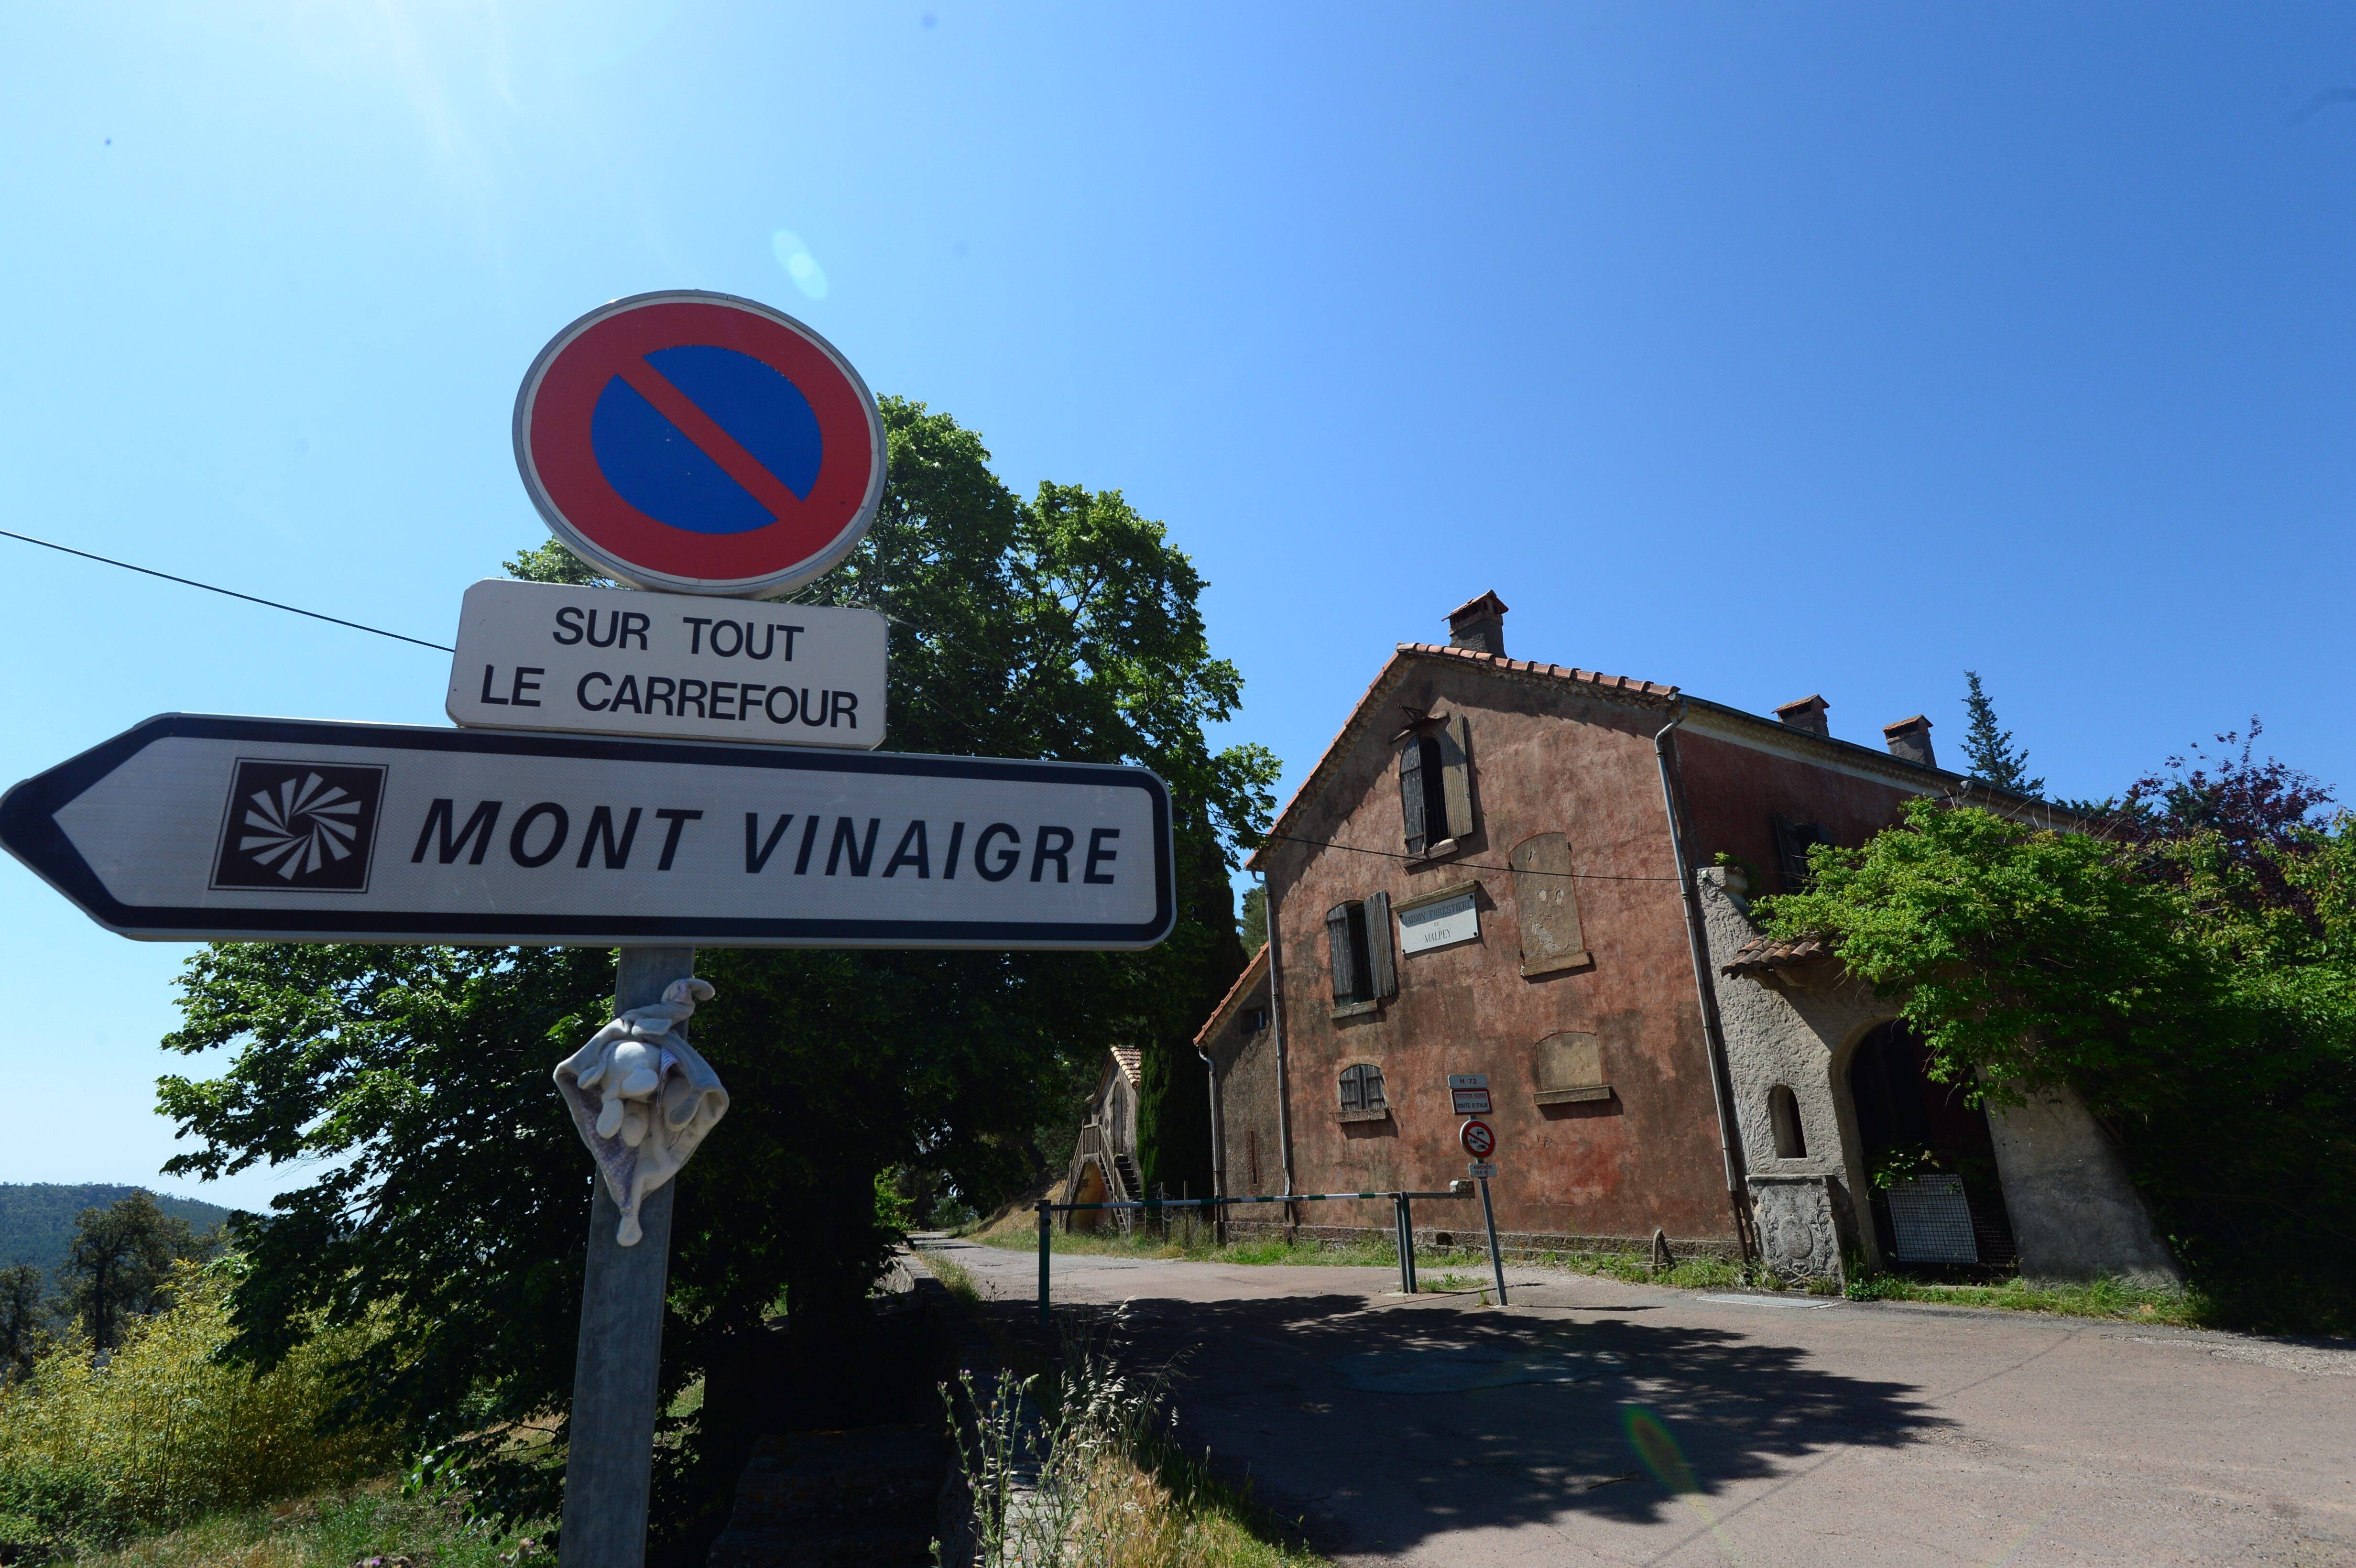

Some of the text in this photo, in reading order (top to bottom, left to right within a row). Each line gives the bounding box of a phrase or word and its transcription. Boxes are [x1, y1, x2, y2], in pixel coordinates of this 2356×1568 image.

[553, 606, 805, 662] SUR TOUT
[480, 664, 859, 730] LE CARREFOUR
[410, 798, 1121, 884] MONT VINAIGRE
[1401, 912, 1426, 925] MAISON
[1424, 928, 1451, 944] MALPEY
